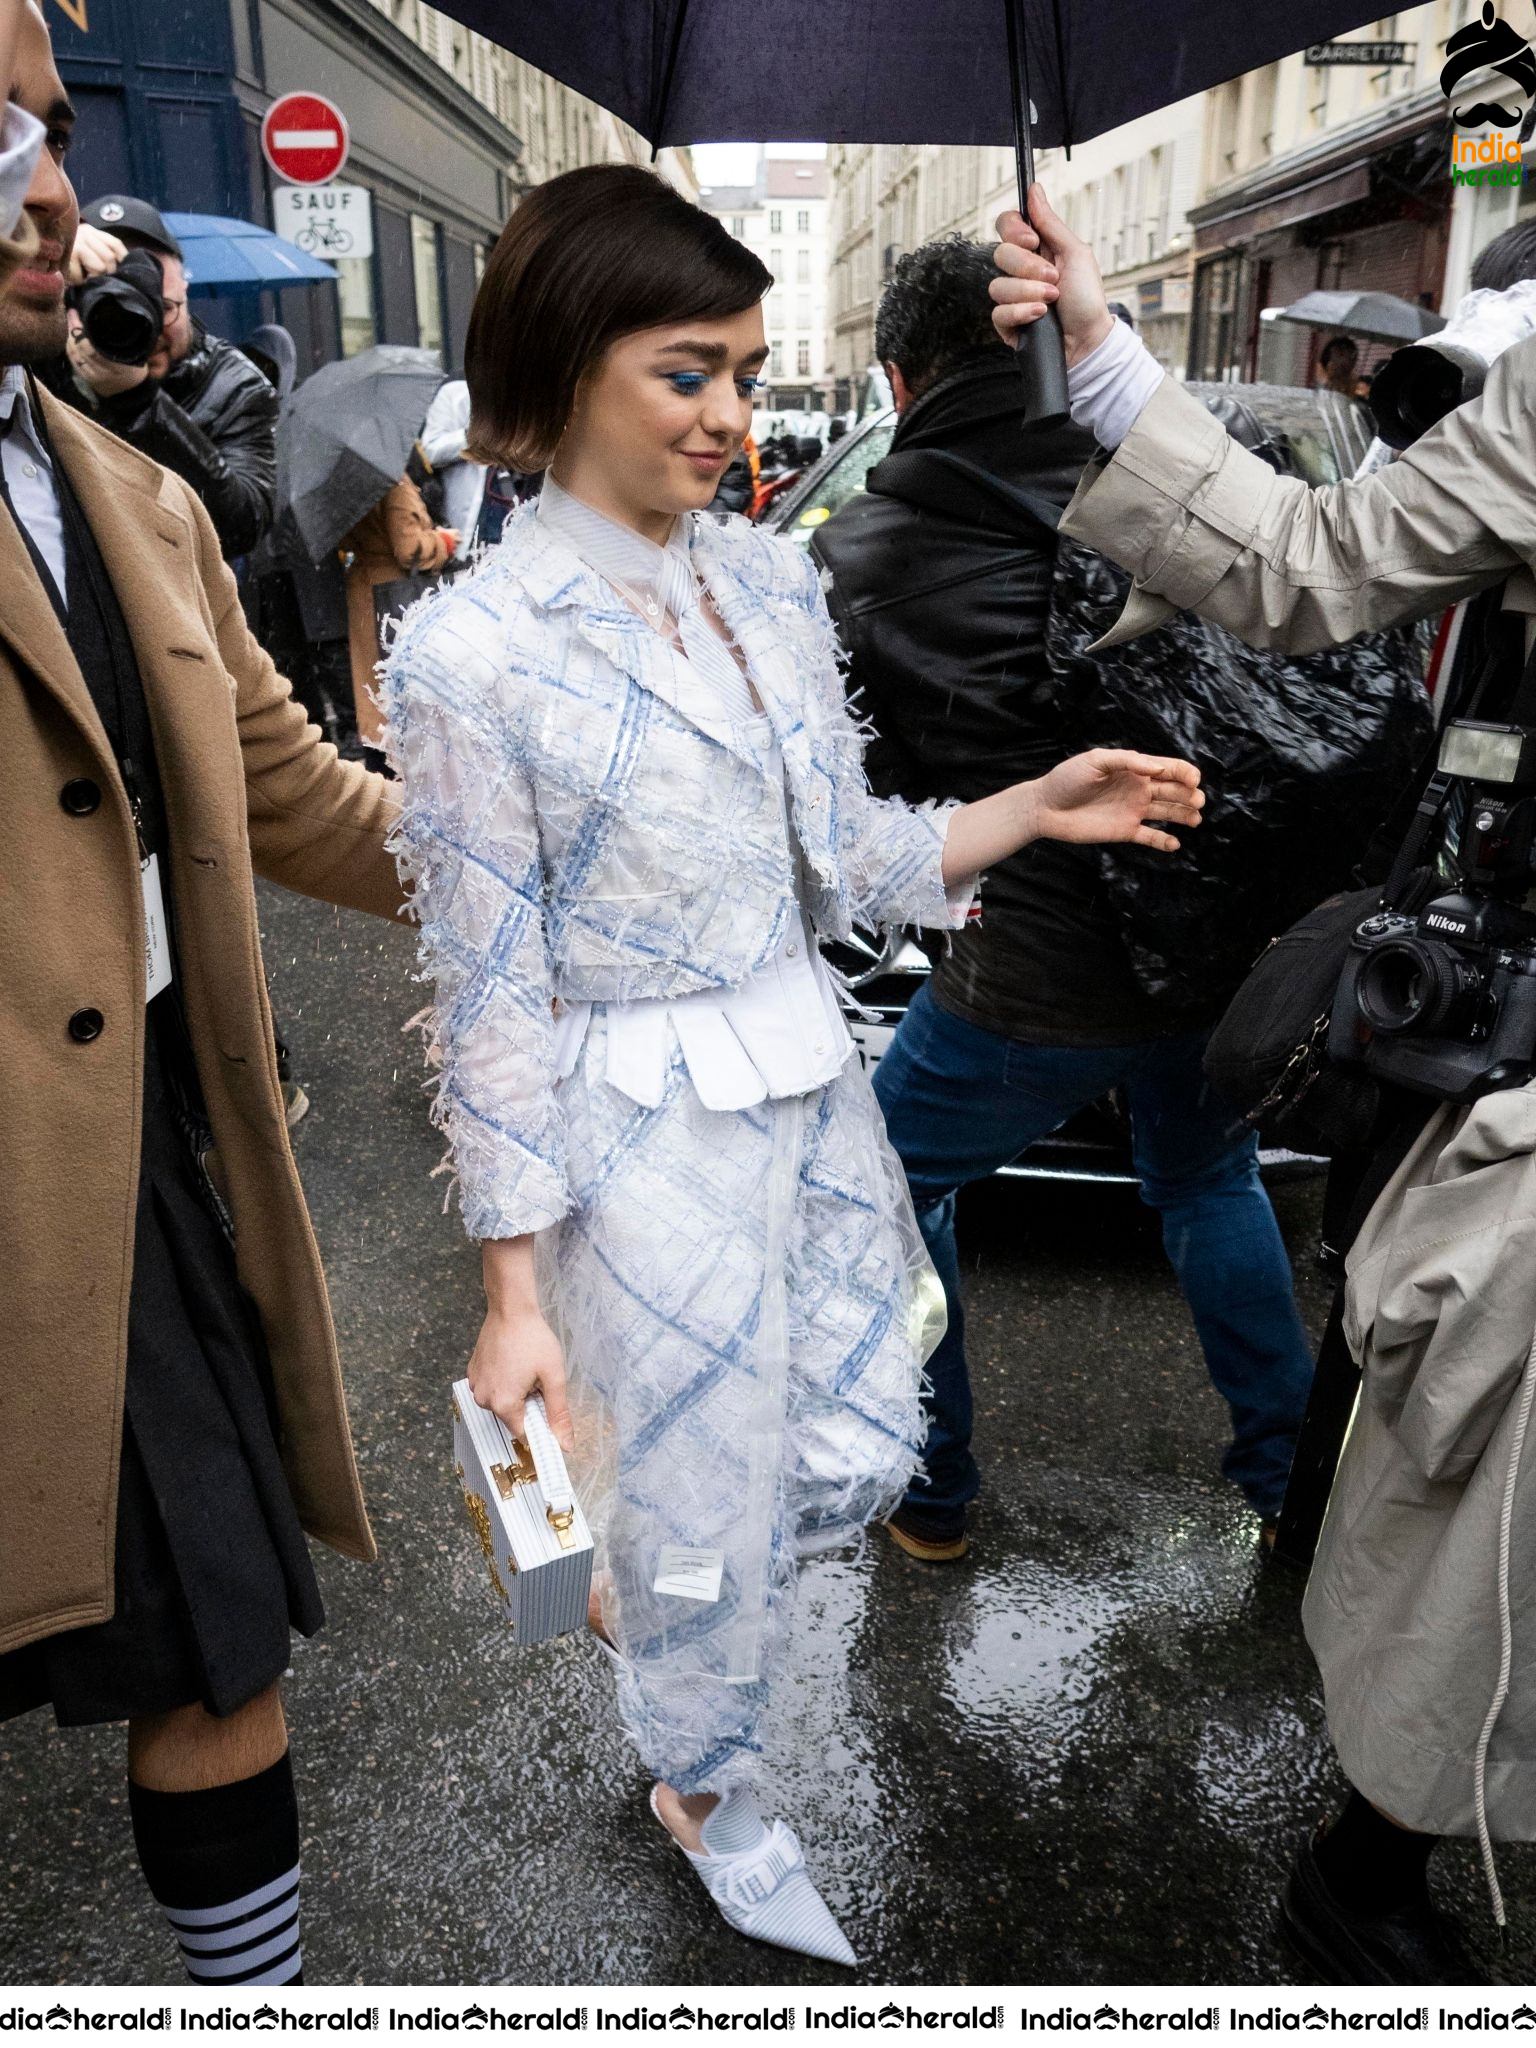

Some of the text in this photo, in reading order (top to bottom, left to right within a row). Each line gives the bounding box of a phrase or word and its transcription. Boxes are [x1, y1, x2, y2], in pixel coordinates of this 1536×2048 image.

[1306, 44, 1402, 62] CARRETTA
[292, 193, 351, 209] SAUF
[1426, 914, 1466, 933] Nikon
